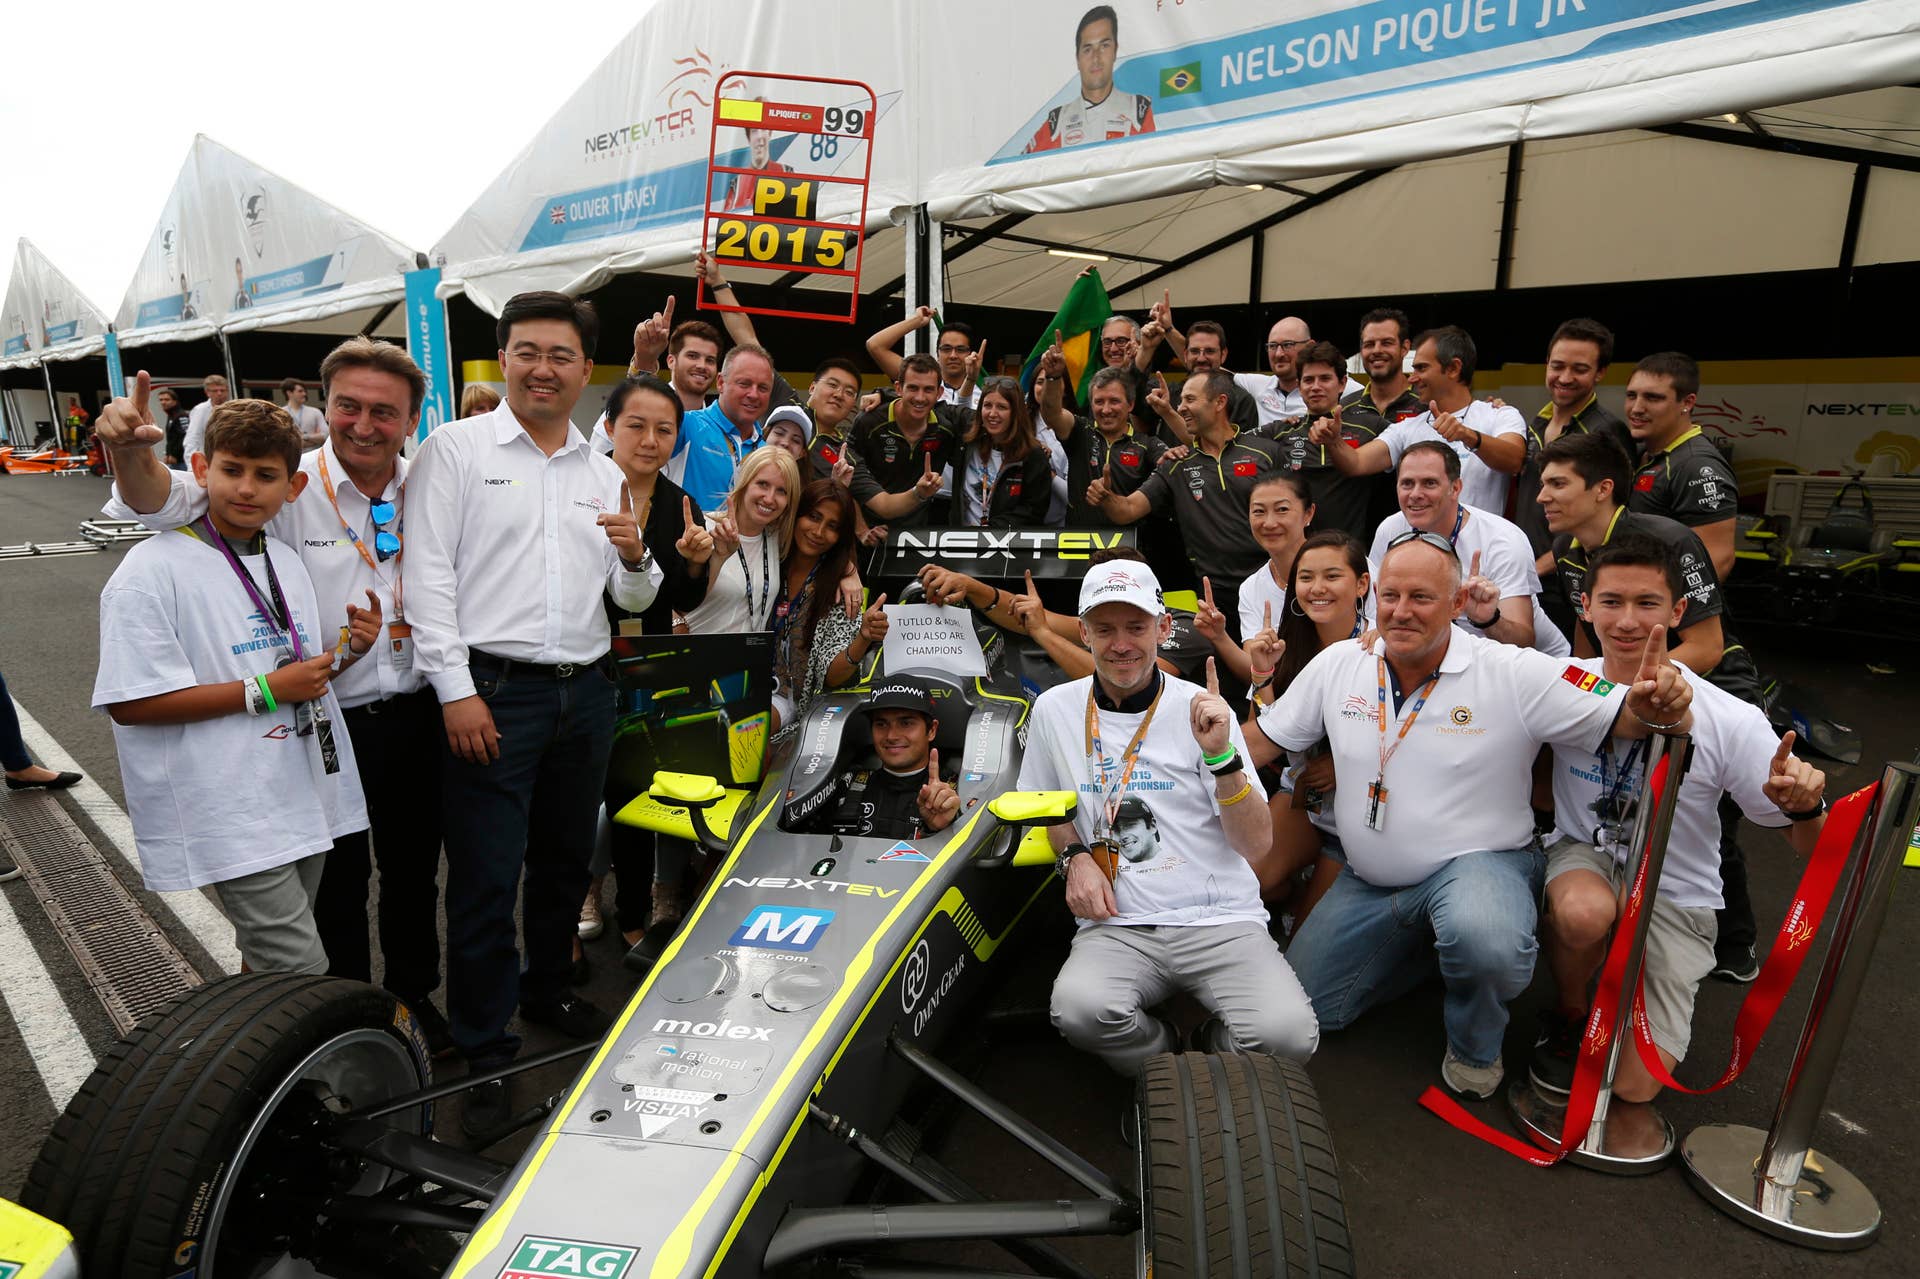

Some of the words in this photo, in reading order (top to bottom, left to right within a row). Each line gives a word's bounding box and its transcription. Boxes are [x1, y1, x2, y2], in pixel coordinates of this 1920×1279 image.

[1219, 25, 1360, 88] NELSON
[1373, 0, 1519, 56] PIQUET
[585, 119, 652, 154] NEXTEV
[655, 108, 694, 134] TCR
[824, 107, 864, 135] 99
[809, 133, 839, 162] 88
[570, 196, 610, 222] OLIVER
[612, 184, 658, 214] TURVEY
[754, 178, 812, 218] P1
[716, 220, 846, 267] 2015
[896, 530, 1124, 560] NEXTEV
[1683, 582, 1716, 600] molex
[934, 616, 942, 626] &
[901, 632, 921, 641] YOU
[923, 631, 947, 641] ALSO
[949, 631, 966, 640] ARE
[906, 646, 963, 656] CHAMPIONS
[871, 685, 924, 703] QUALCOMM
[803, 711, 835, 776] mouser.com
[972, 711, 994, 773] mouser.com
[1569, 765, 1601, 785] DRIVER
[722, 877, 901, 899] NEXTEV
[742, 911, 823, 945] M
[717, 949, 810, 963] mouser.com
[651, 1018, 776, 1041] molex
[660, 1061, 724, 1081] motion
[679, 1049, 748, 1072] rational
[623, 1099, 709, 1119] VISHAY
[183, 1181, 210, 1237] MICHELIN
[527, 1242, 623, 1278] TAG
